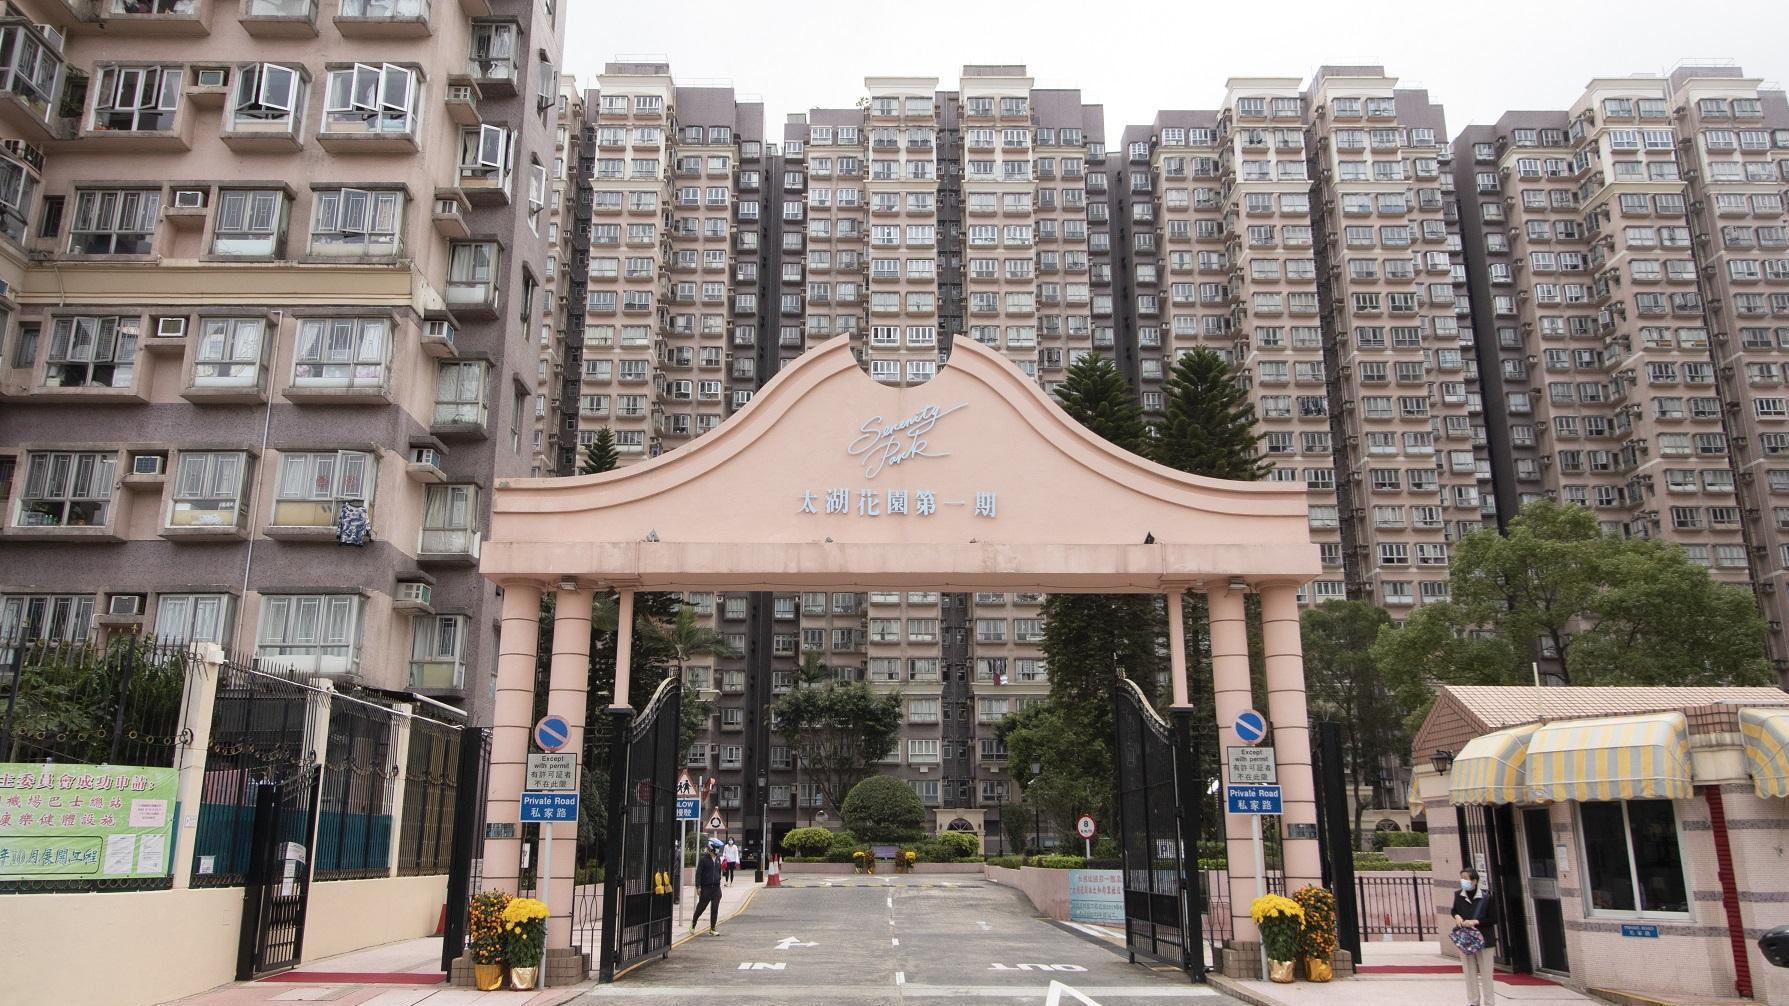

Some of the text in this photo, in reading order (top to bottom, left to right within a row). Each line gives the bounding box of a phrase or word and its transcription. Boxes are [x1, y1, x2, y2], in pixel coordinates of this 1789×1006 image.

[847, 402, 968, 456] Serenity
[861, 429, 952, 480] Park
[798, 487, 997, 519] 太湖花園第一期
[534, 780, 567, 788] 不在此限
[1229, 789, 1279, 797] Private Road
[0, 794, 122, 809] 機場巴士總站
[524, 797, 576, 805] Private Road
[1238, 799, 1272, 811] 私家路
[530, 807, 567, 819] 私家路
[737, 962, 787, 970] IN
[987, 963, 1089, 972] OUT
